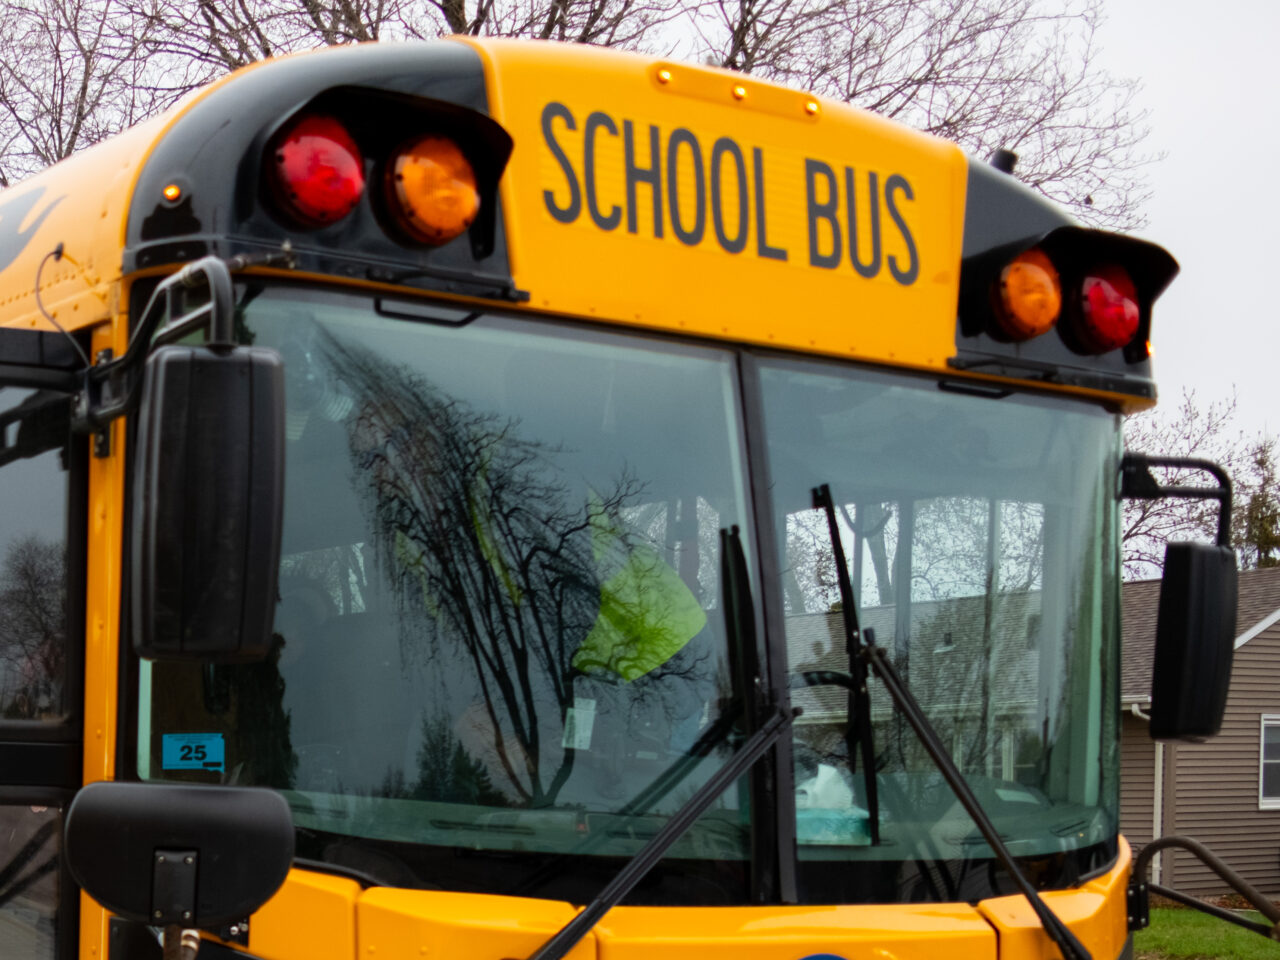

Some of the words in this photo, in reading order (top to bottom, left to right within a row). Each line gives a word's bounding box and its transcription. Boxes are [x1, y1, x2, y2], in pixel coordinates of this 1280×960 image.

[540, 101, 788, 262] SCHOOL
[805, 158, 920, 287] BUS
[180, 744, 207, 761] 25
